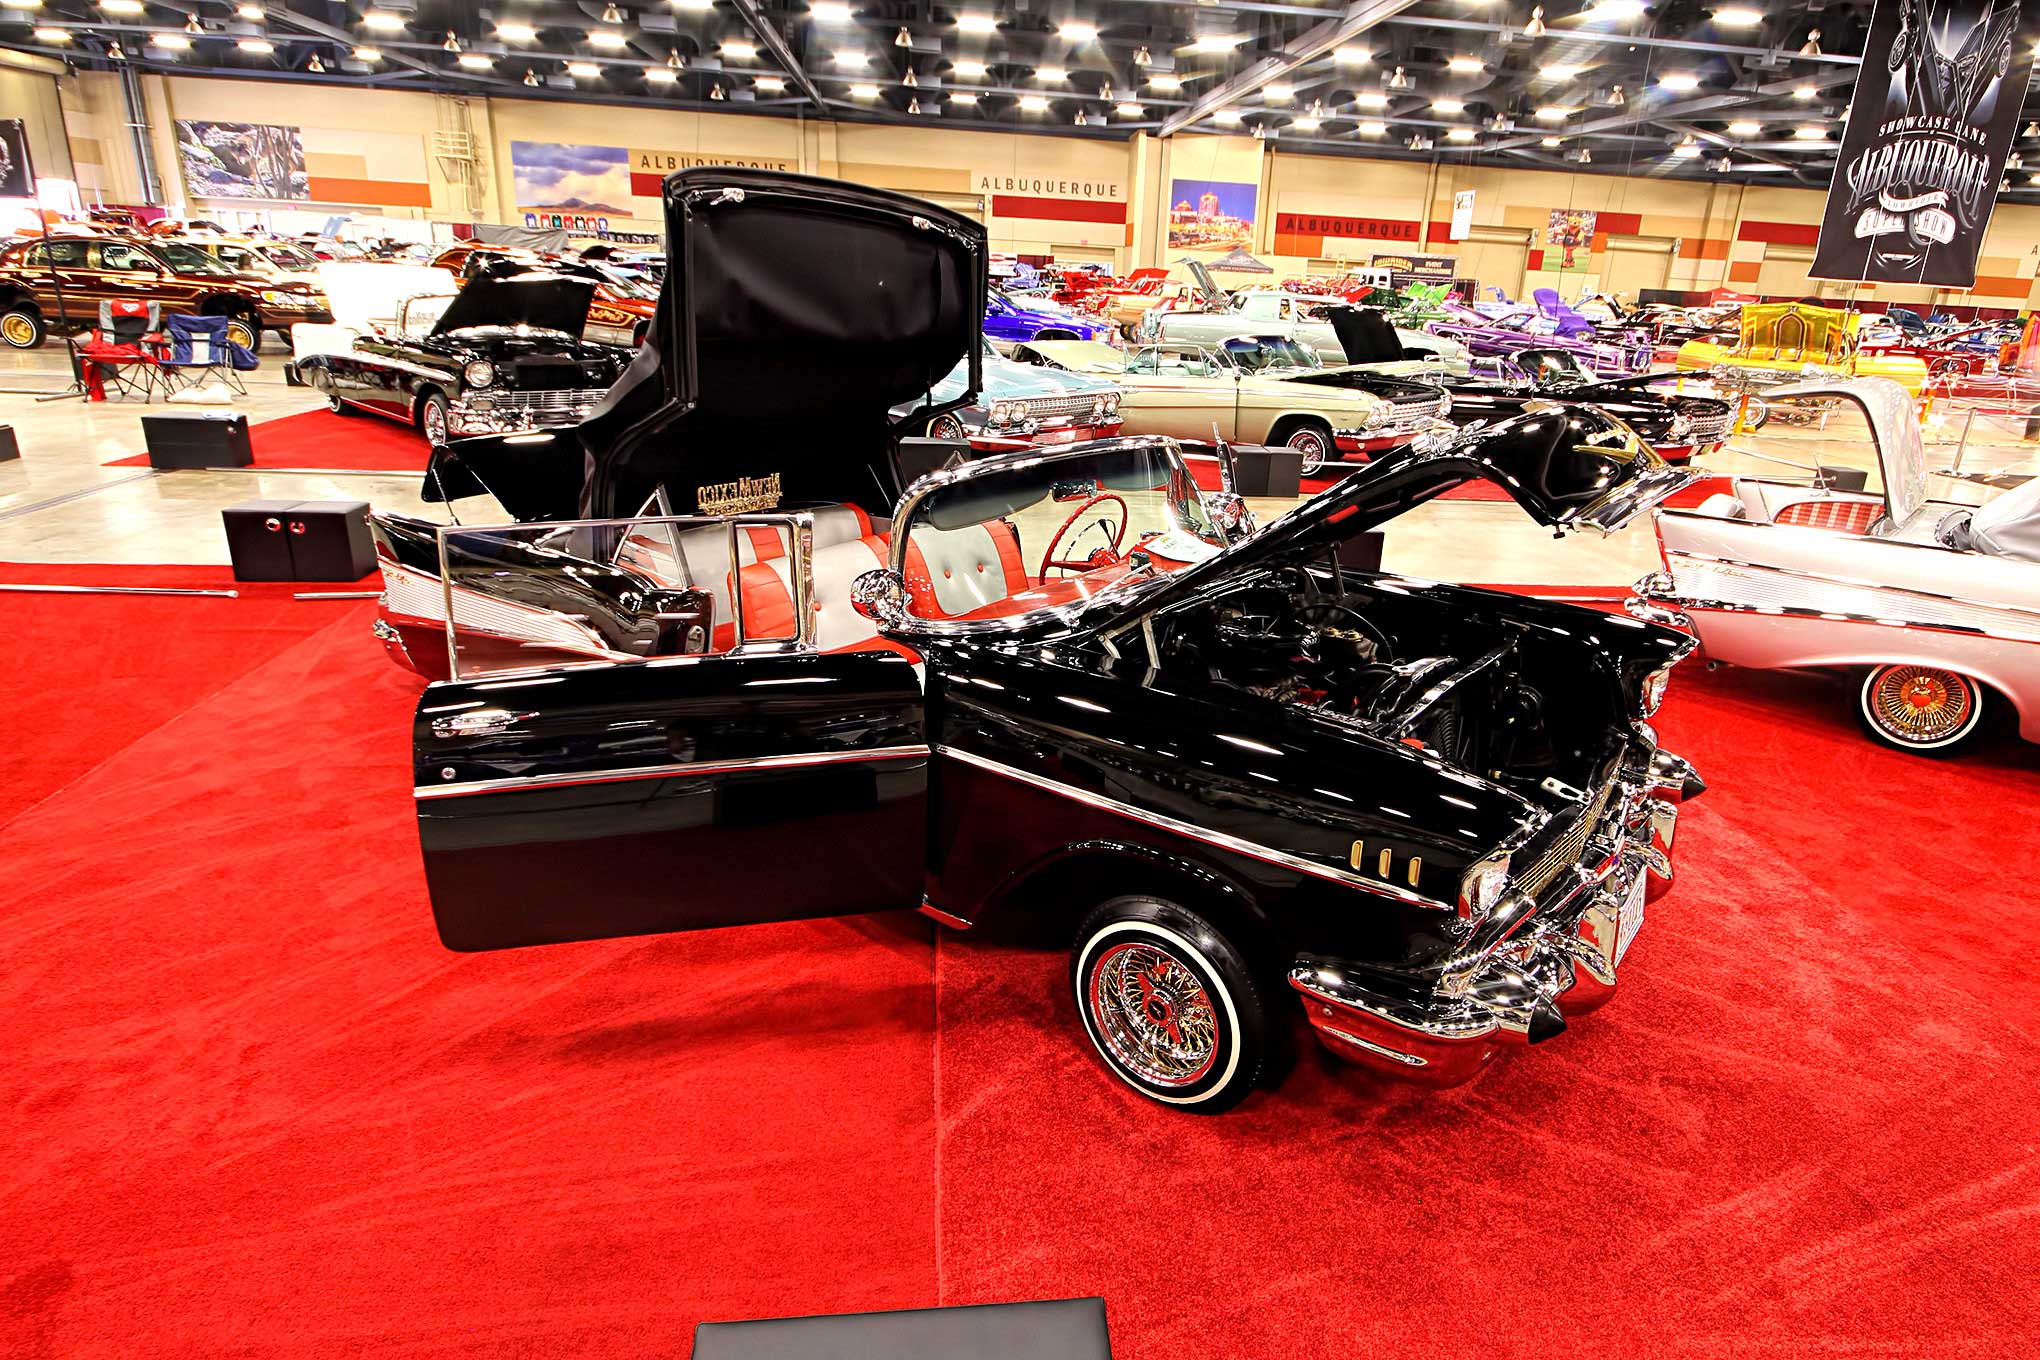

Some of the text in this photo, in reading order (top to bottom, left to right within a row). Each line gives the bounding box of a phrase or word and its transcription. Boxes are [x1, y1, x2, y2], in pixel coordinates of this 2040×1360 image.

[1878, 115, 1989, 147] SHOWCASE LANE
[981, 177, 1118, 198] ALBUQUERQUE
[1846, 139, 1991, 224] ALBUQUERQUE
[1887, 194, 1939, 209] LOWRIDER
[1286, 217, 1412, 238] ALBUQUERQUE
[1914, 211, 1948, 235] SHOW
